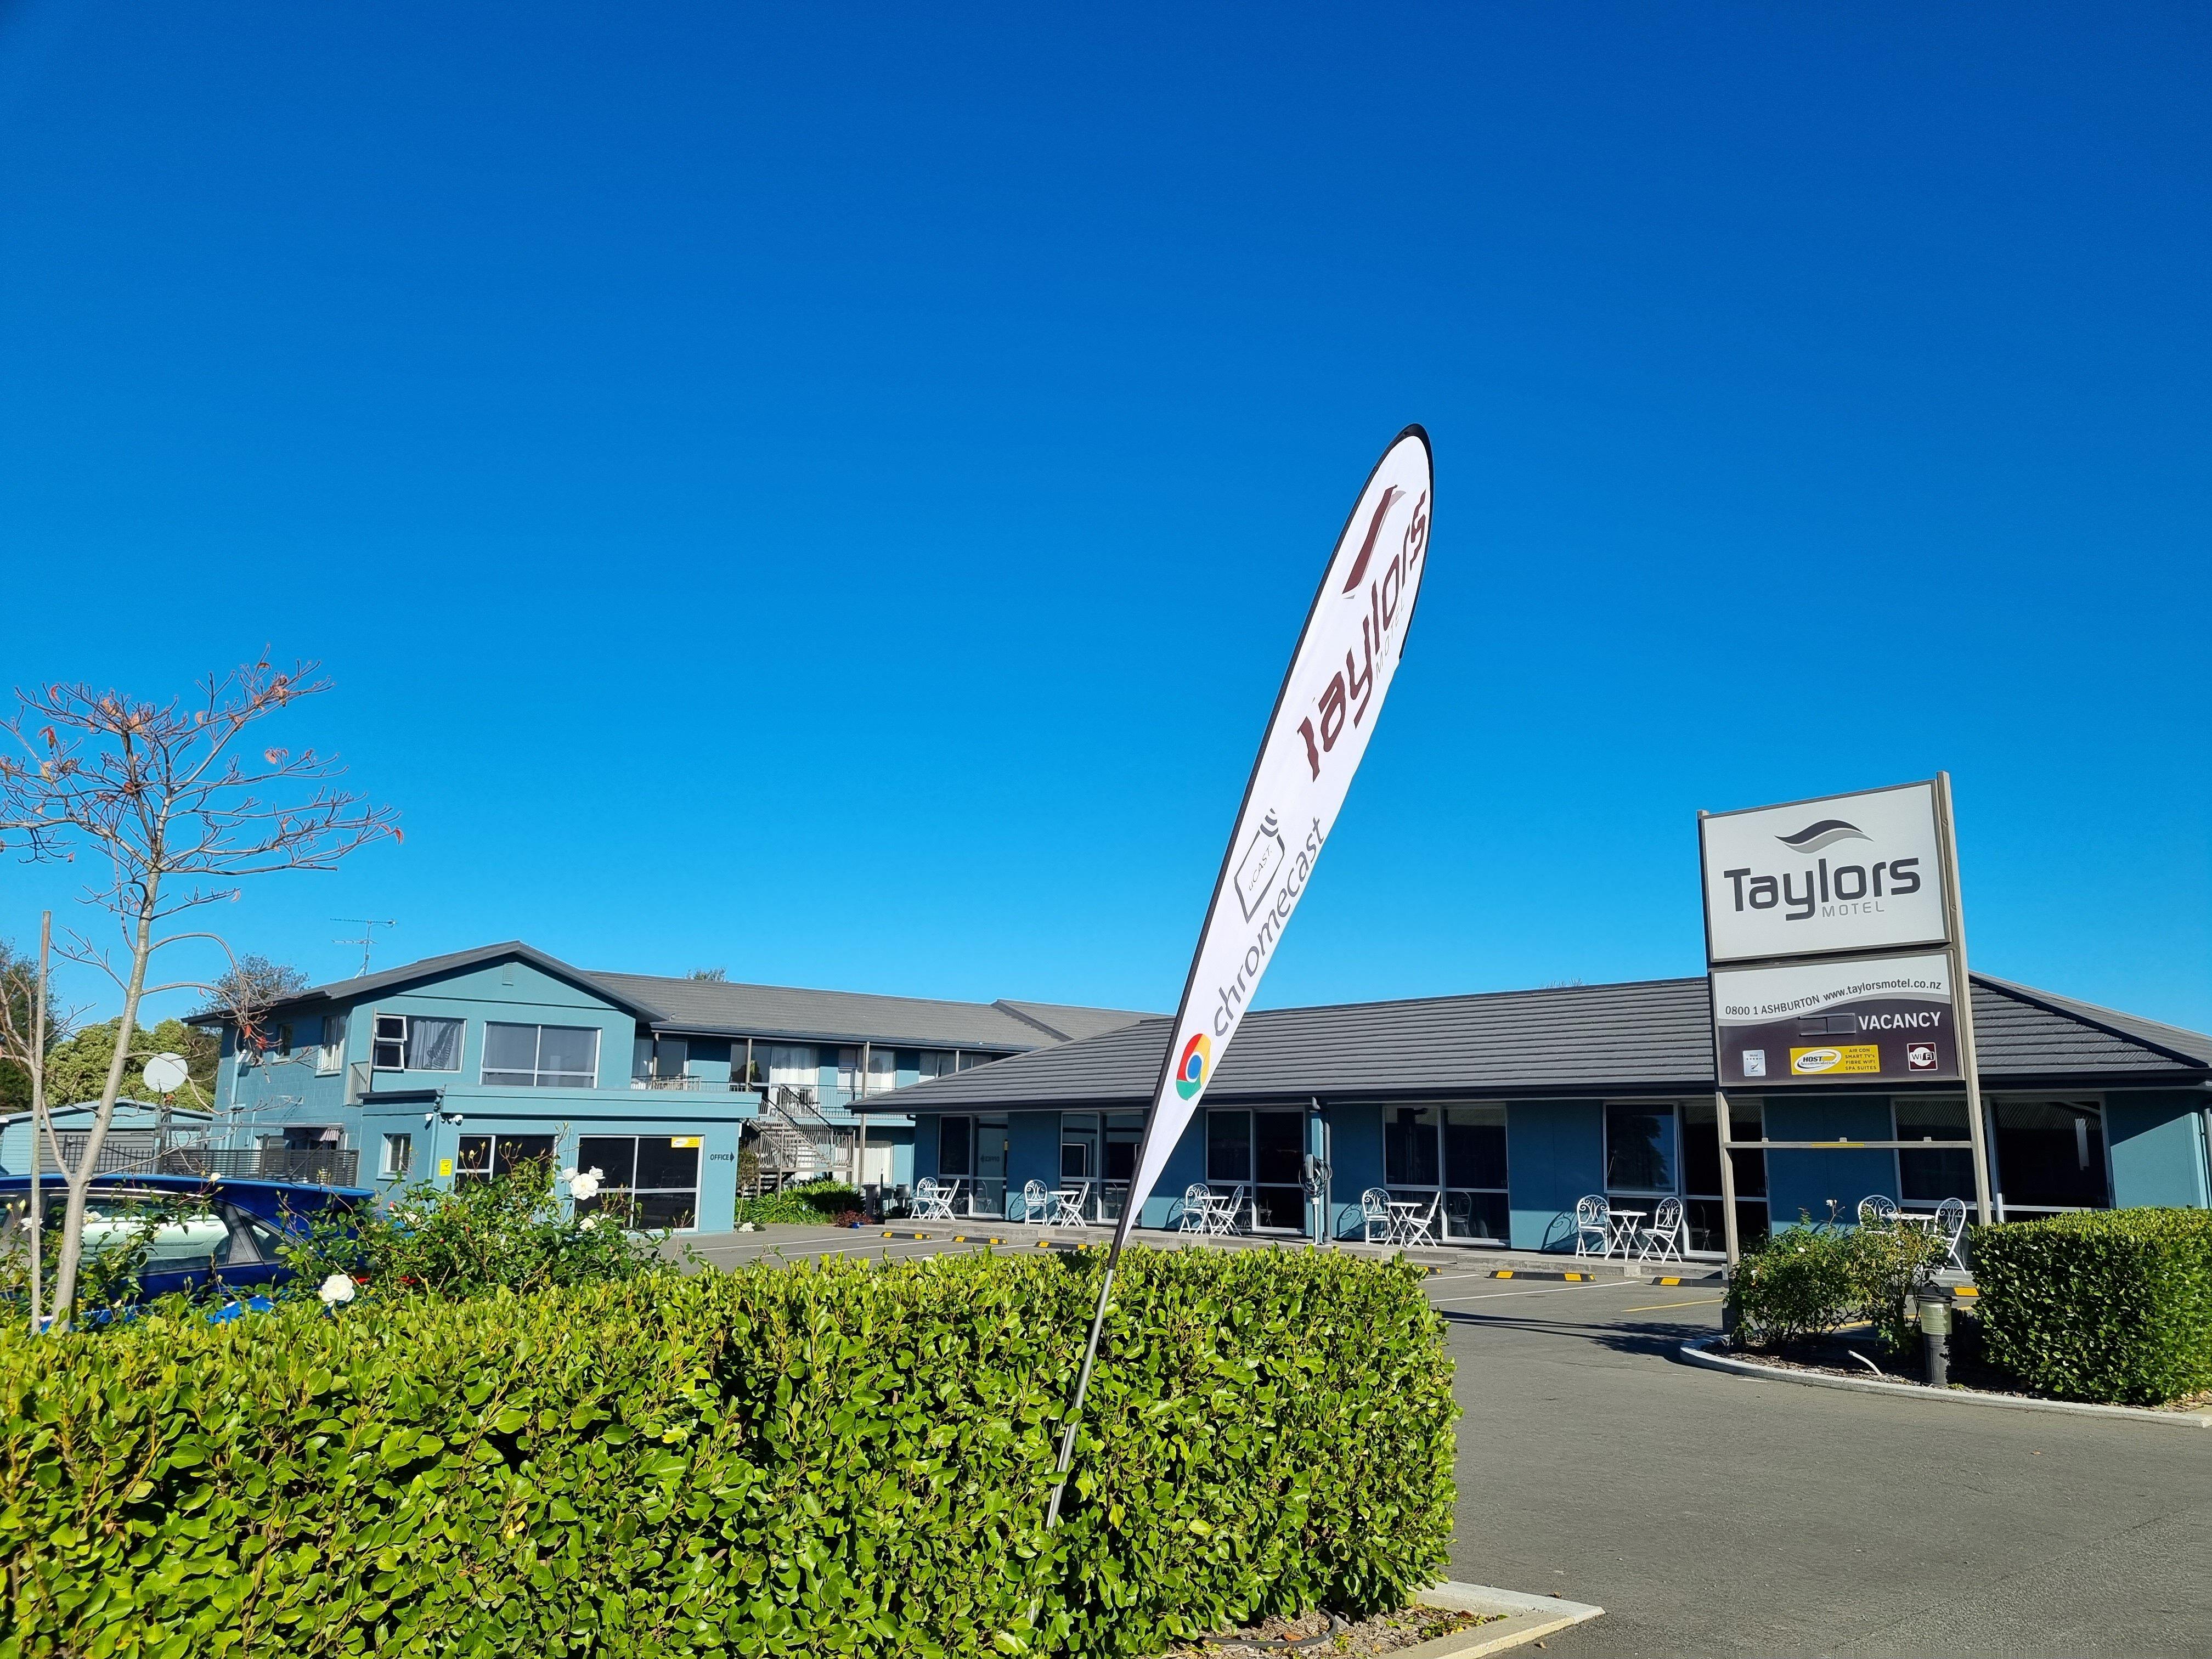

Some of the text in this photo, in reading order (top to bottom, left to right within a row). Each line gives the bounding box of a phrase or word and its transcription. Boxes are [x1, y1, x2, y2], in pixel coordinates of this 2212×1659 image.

[1375, 596, 1405, 680] MOTEL
[1723, 857, 1921, 921] Taylors
[1821, 900, 1884, 918] MOTEL
[1214, 816, 1324, 1037] chromecast
[1725, 978, 1942, 1015] 0800 1 ASHBURTON www.taylorsmotel.co.nz
[1858, 1011, 1941, 1030] VACANCY
